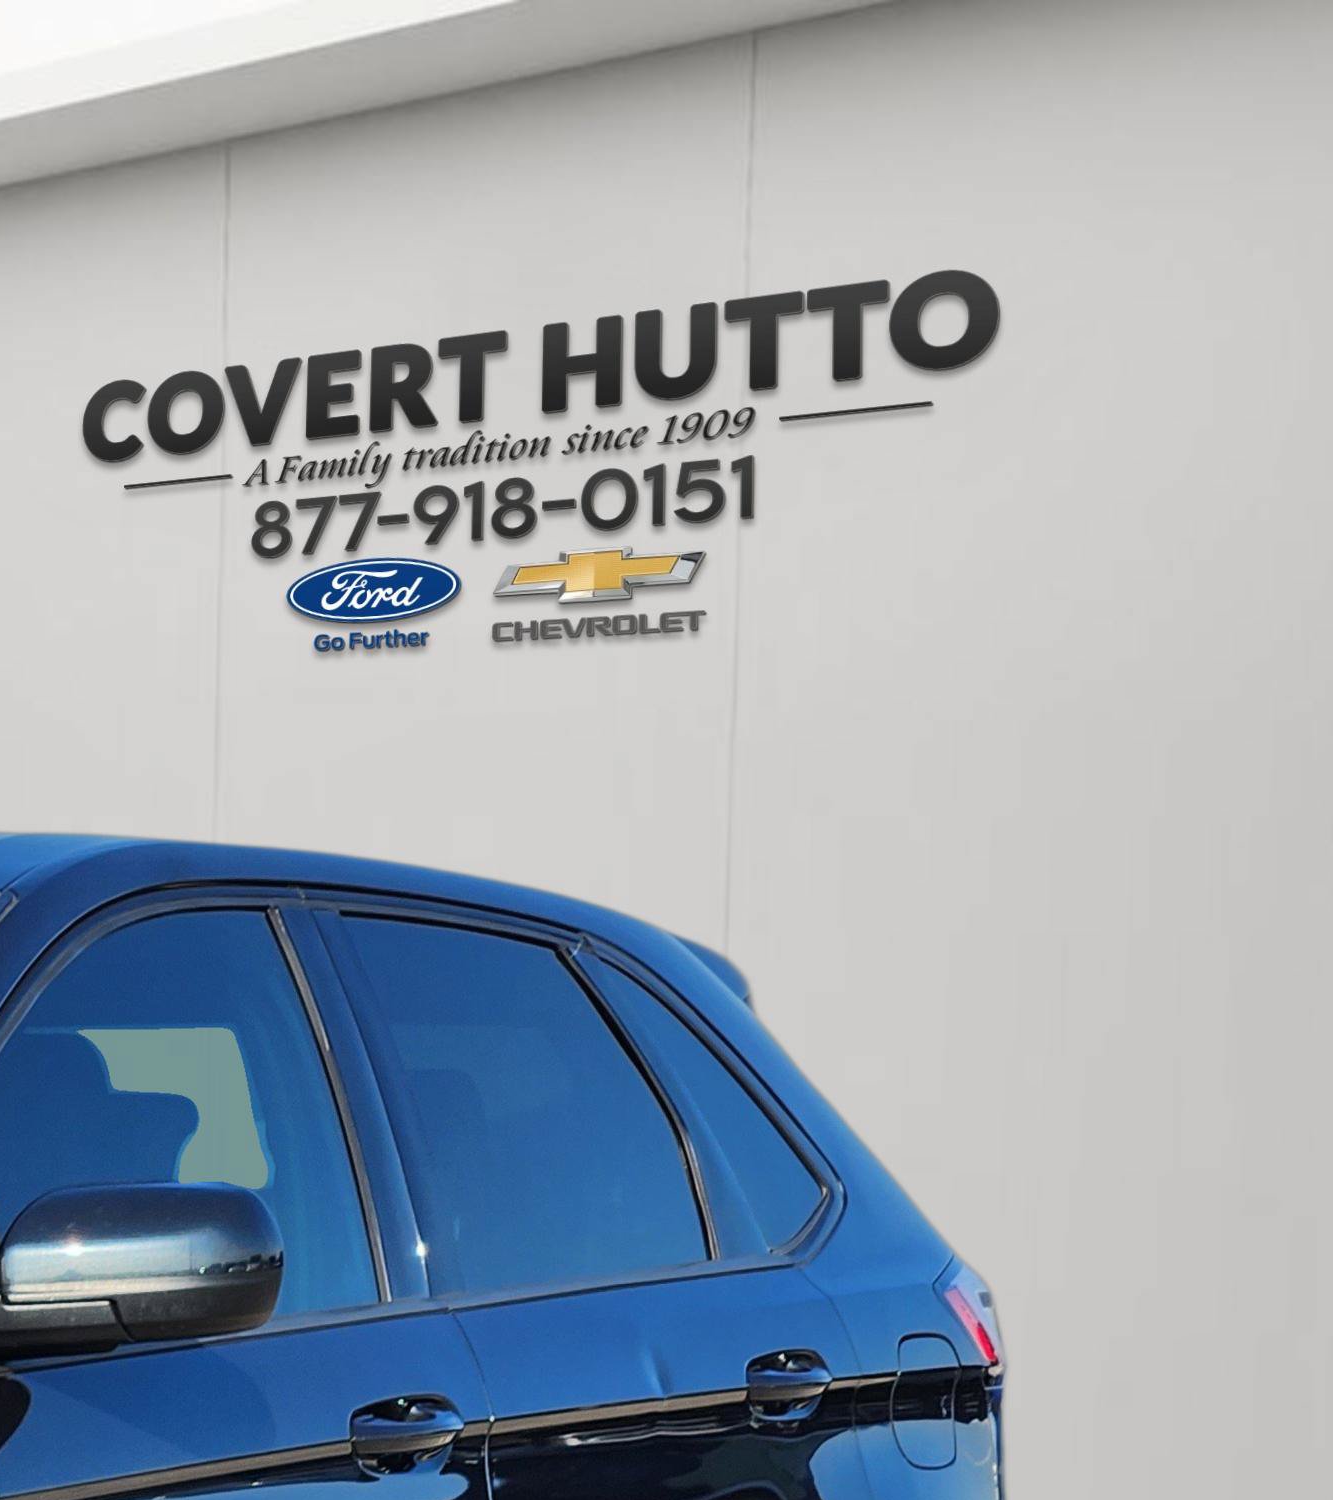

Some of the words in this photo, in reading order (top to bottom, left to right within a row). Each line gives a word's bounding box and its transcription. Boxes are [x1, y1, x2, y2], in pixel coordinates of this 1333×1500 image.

[82, 330, 509, 464] COVERT
[541, 269, 1001, 415] HUTTO
[242, 458, 269, 488] A
[275, 440, 392, 489] Family
[401, 429, 552, 472] tradition
[560, 422, 650, 456] since
[656, 406, 757, 446] 1909
[251, 455, 755, 560] 877-918-0151
[320, 569, 423, 611] Ford
[313, 634, 346, 653] Go
[348, 628, 430, 651] Further
[491, 610, 708, 643] CHEVROLET
